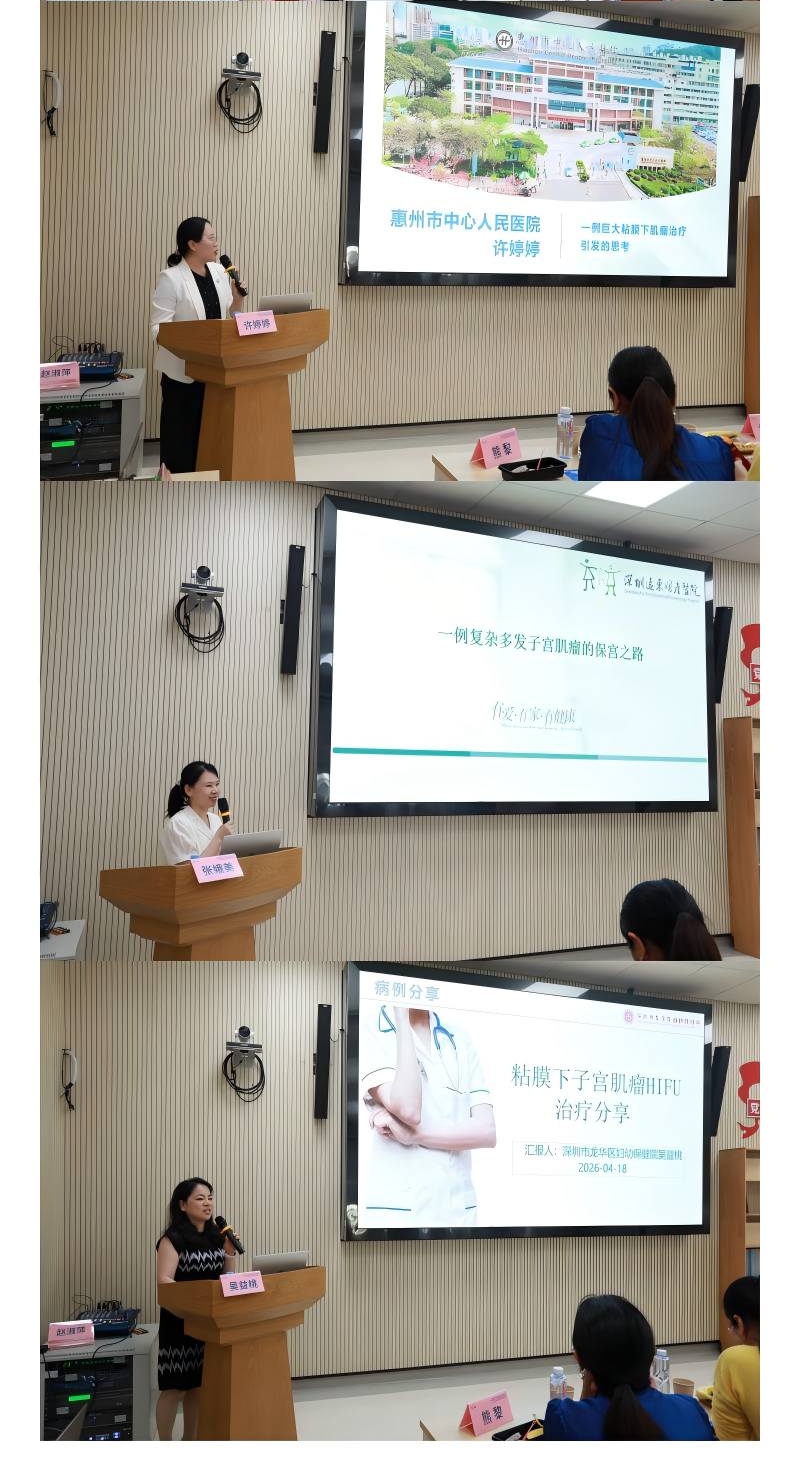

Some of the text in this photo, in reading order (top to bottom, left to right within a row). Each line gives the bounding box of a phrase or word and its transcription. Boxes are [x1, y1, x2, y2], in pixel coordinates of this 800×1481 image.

[391, 208, 541, 232] 惠州市中心人民医院
[493, 239, 541, 257] 许婷婷
[581, 239, 630, 252] 引发的思考
[438, 626, 644, 661] 一例复杂多发子宫肌瘤的保宫之路
[375, 980, 440, 1001] 病例分享
[511, 1063, 681, 1096] 粘膜下子宫肌瘤HIFU
[555, 1098, 630, 1124] 治疗分享
[578, 1163, 627, 1173] 2026-04-18
